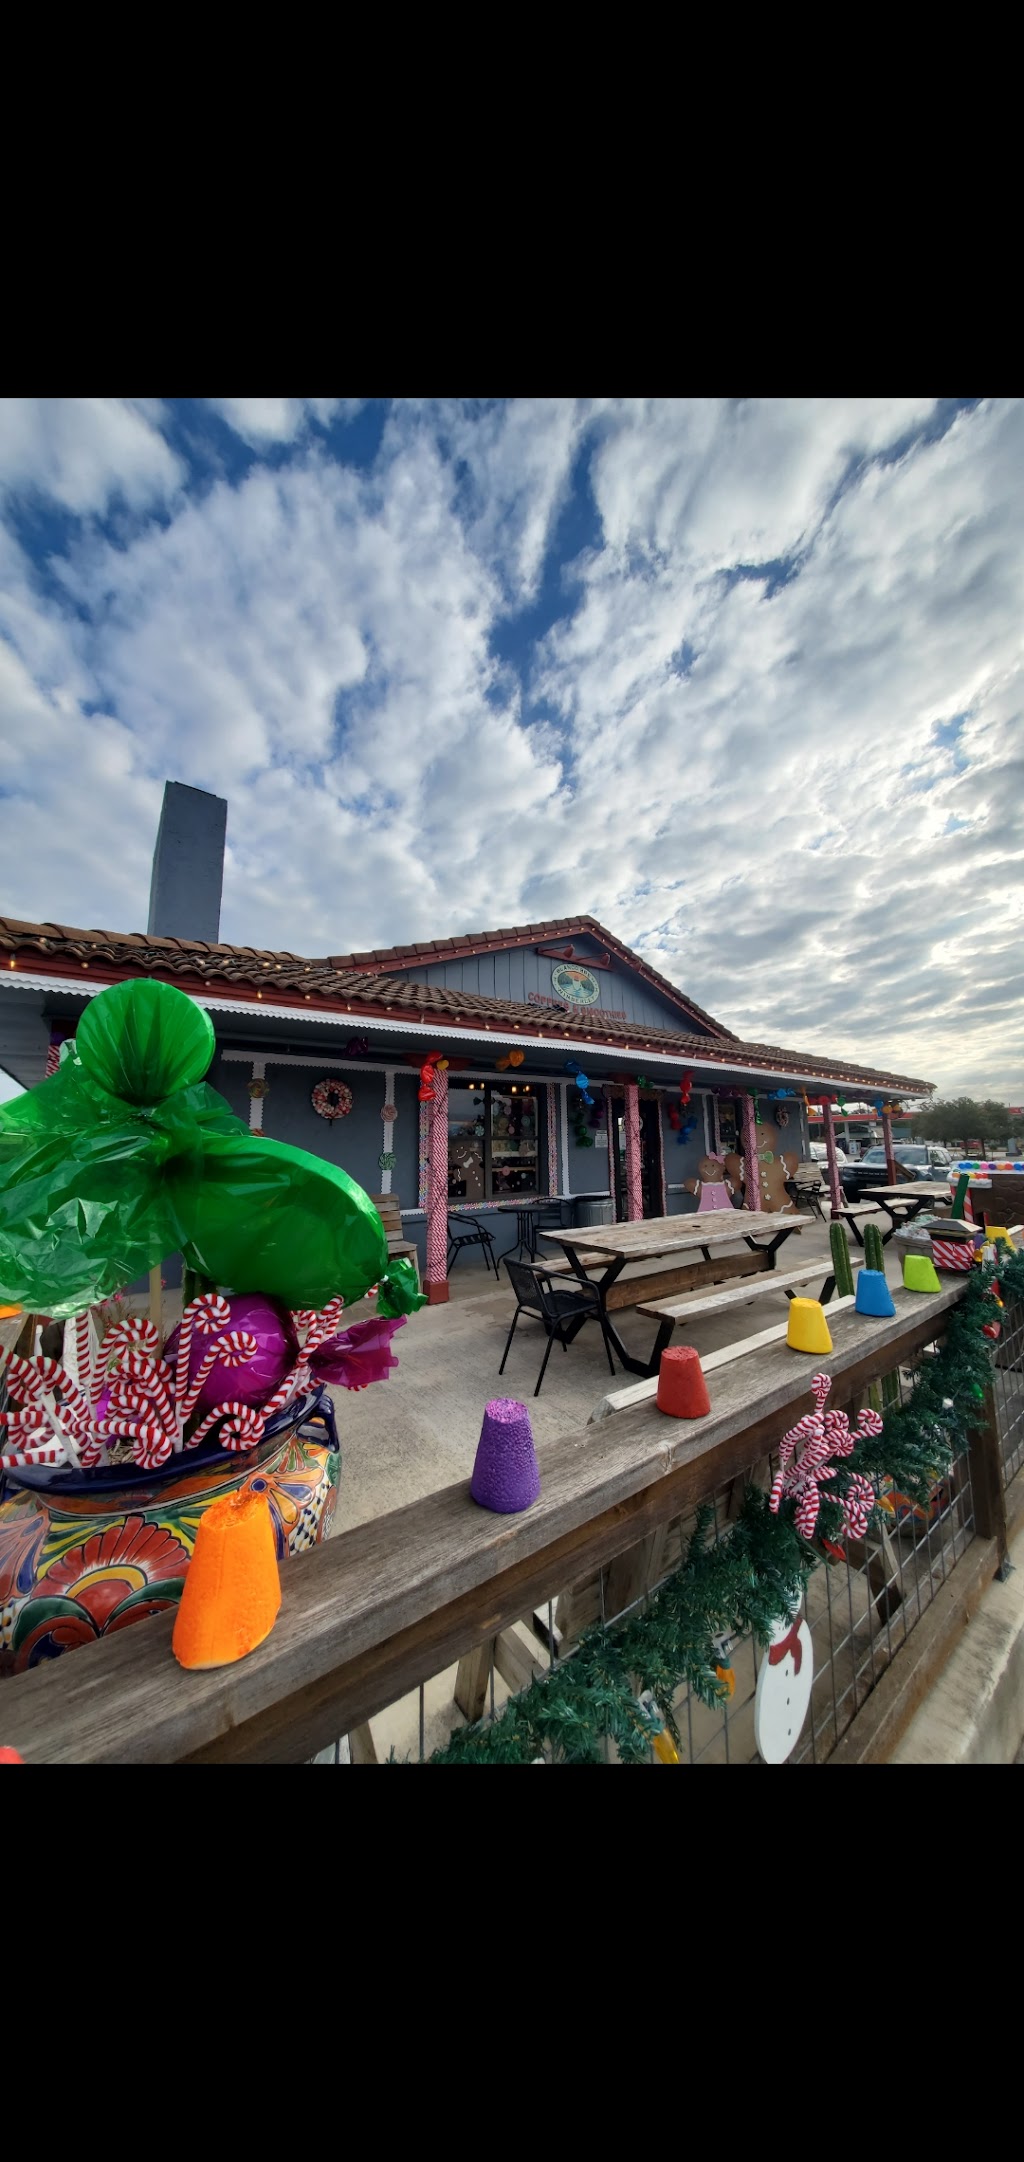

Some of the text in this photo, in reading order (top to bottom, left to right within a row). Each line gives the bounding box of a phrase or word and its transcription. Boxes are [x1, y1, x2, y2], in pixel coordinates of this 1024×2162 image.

[556, 964, 578, 974] BLANCO
[558, 989, 595, 1004] WIMBERLEY
[580, 1006, 627, 1019] SMOOTHIES
